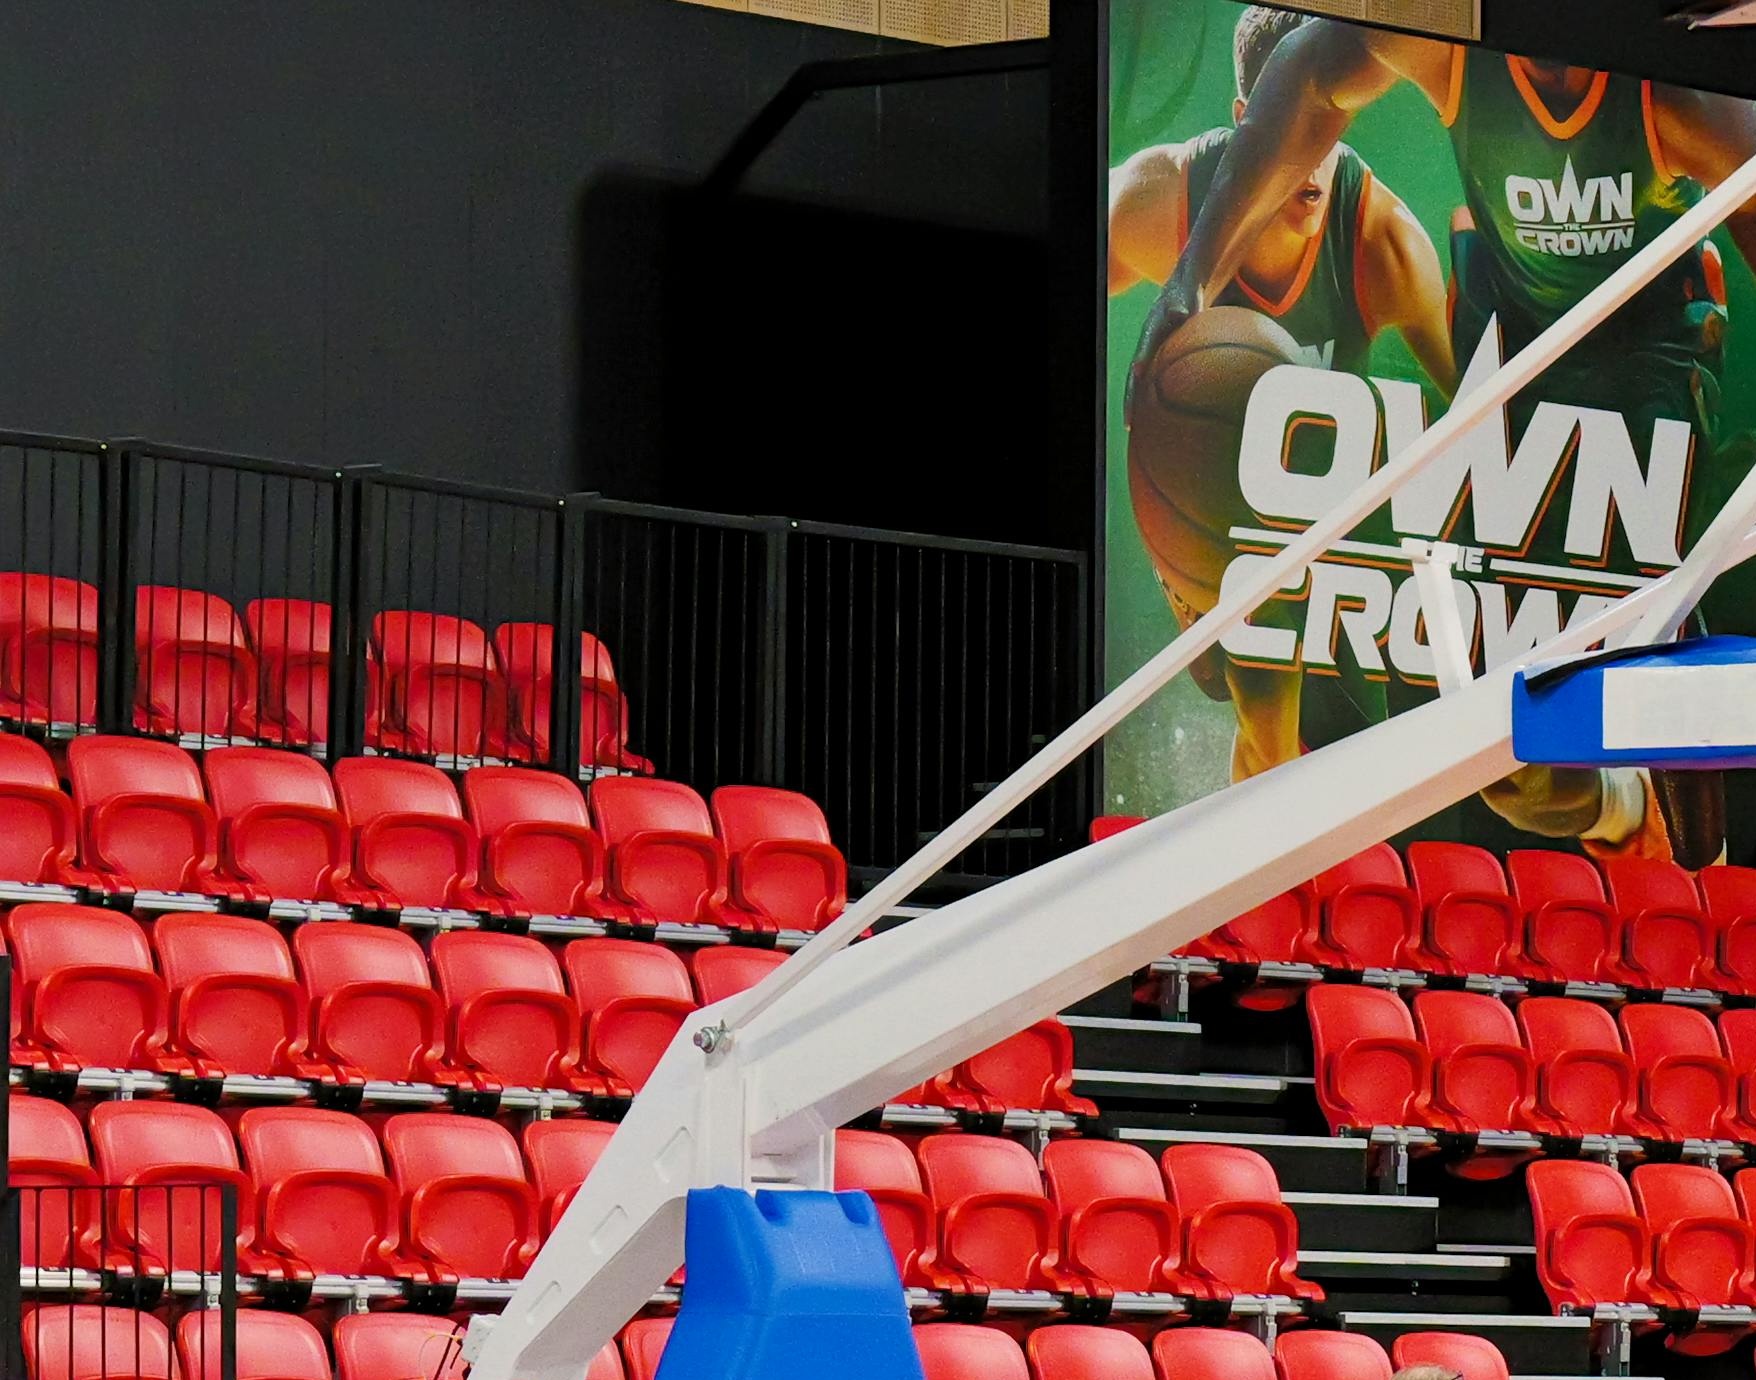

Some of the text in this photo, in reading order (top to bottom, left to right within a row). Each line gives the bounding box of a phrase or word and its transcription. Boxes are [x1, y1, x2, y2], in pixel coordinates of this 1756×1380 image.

[1505, 153, 1634, 223] OWN
[1515, 227, 1634, 257] CROWN
[1238, 311, 1692, 567] OWN
[1218, 553, 1680, 677] CROW
